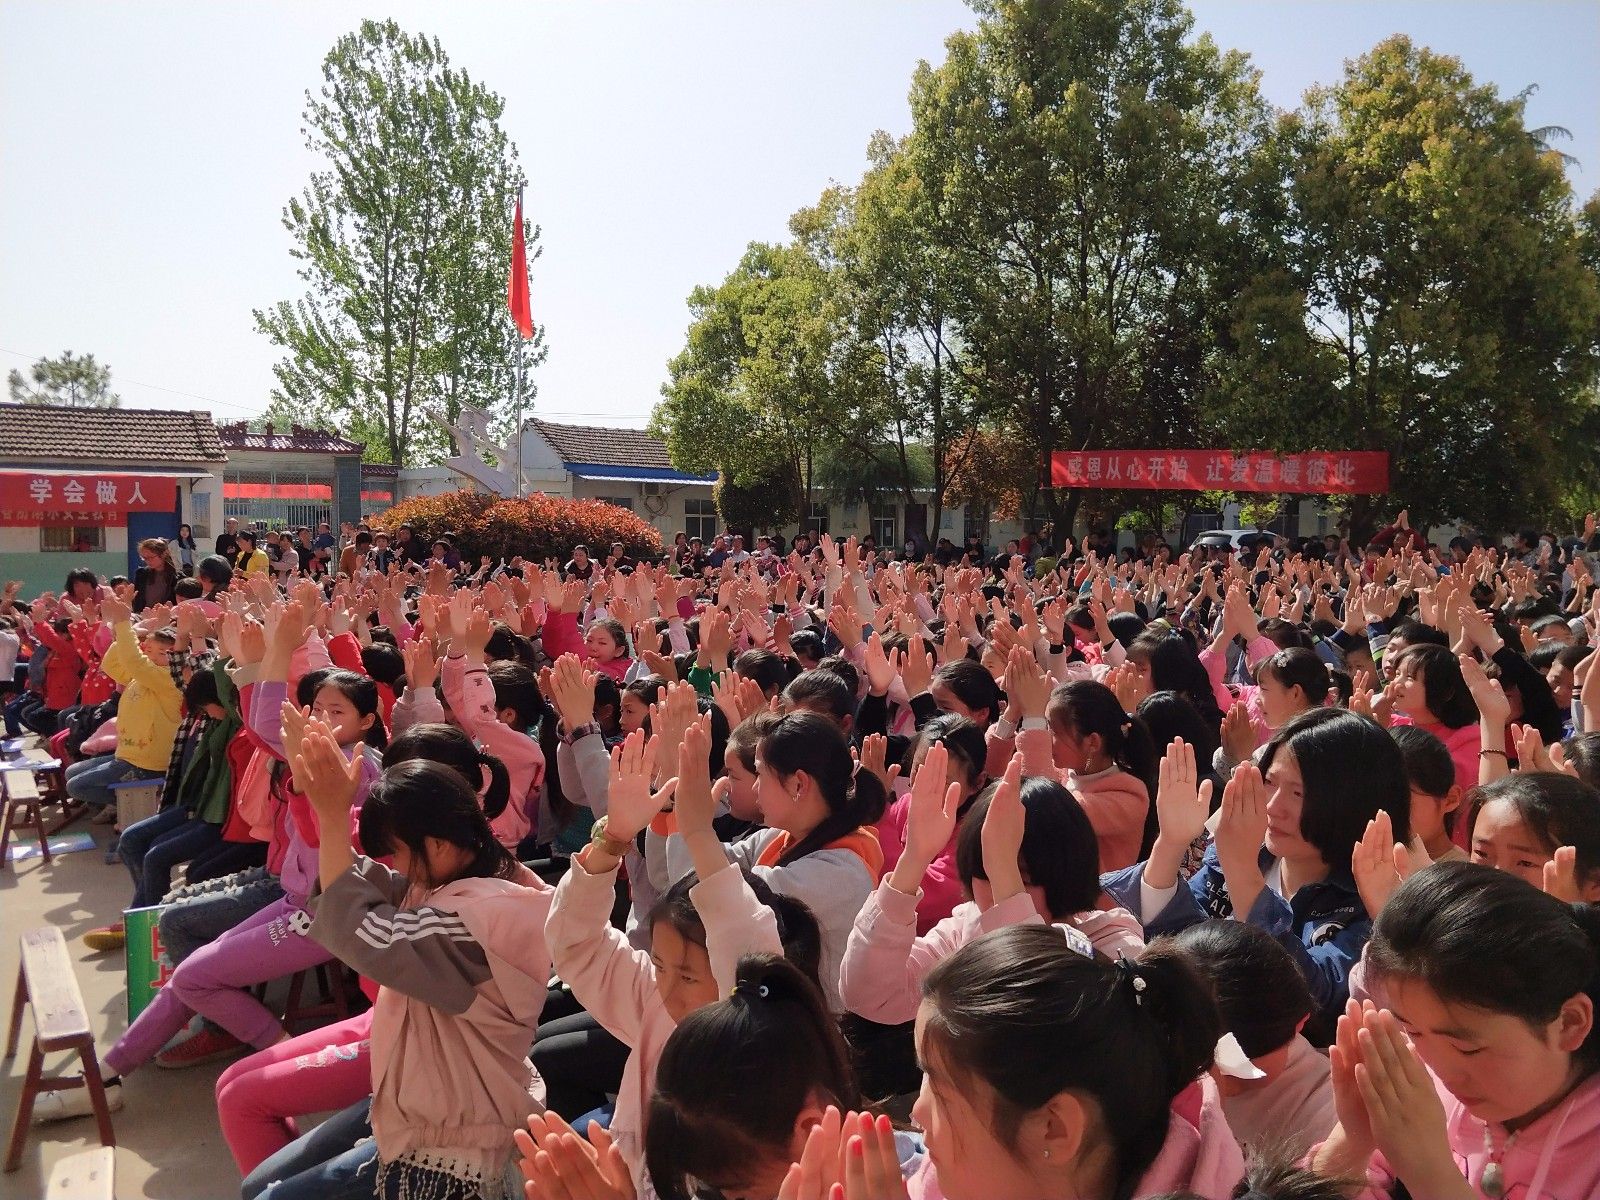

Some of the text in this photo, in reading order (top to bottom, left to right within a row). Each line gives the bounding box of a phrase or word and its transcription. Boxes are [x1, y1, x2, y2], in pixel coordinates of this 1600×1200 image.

[1068, 455, 1356, 486] 感恩从心开始 让爱温暖彼此
[29, 479, 148, 505] 学会做人
[267, 921, 281, 947] ANDA
[276, 917, 289, 939] BABY
